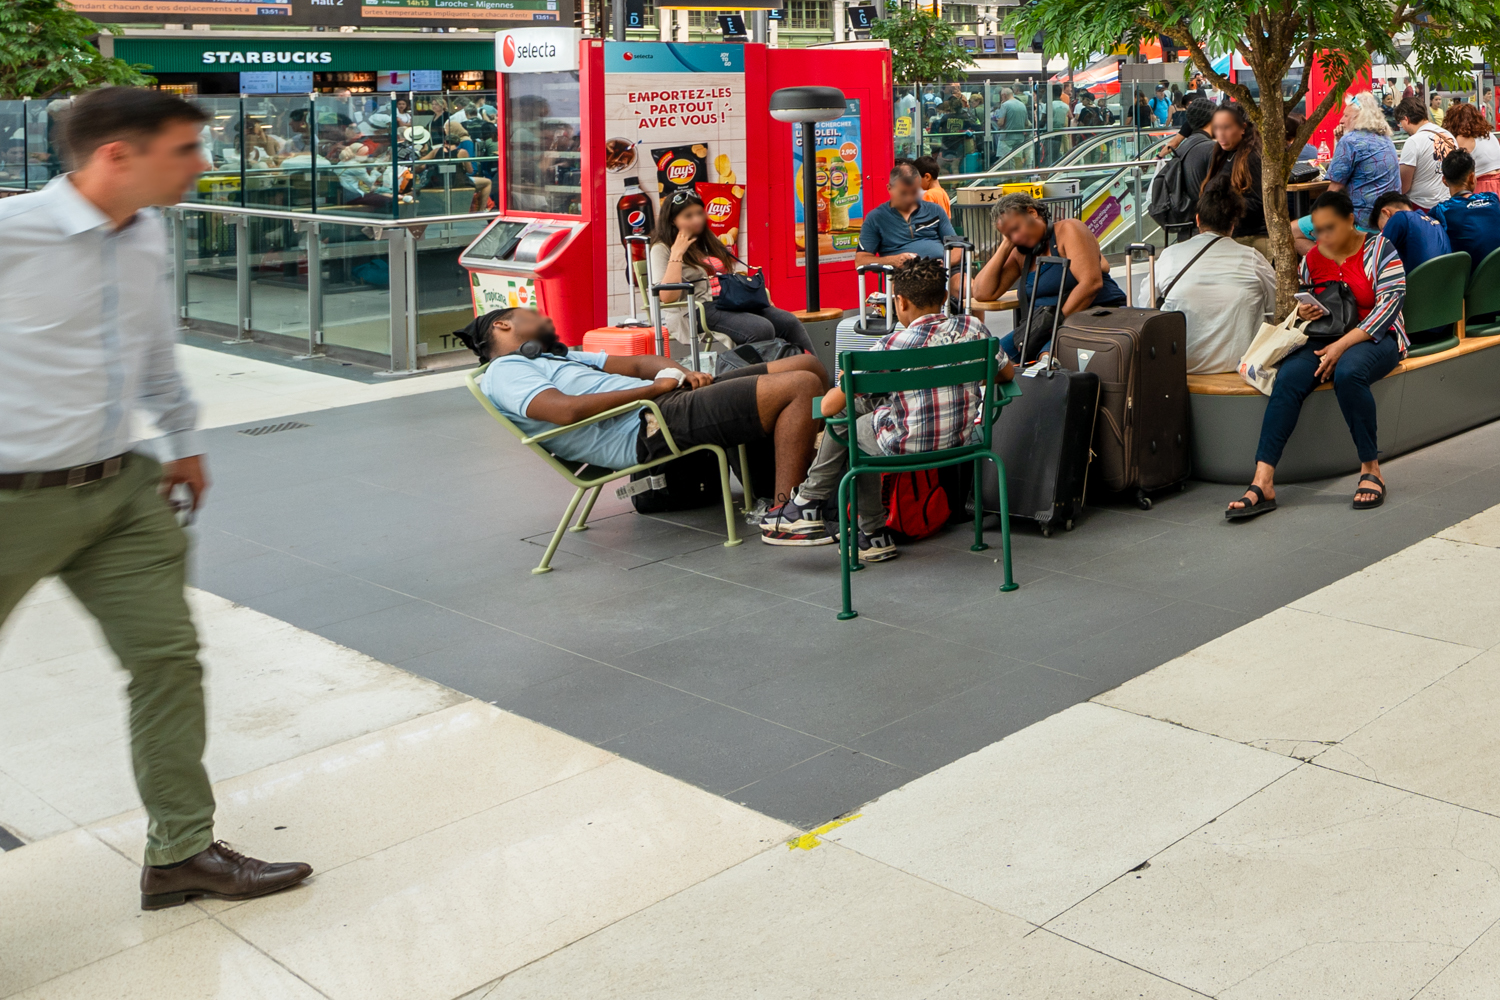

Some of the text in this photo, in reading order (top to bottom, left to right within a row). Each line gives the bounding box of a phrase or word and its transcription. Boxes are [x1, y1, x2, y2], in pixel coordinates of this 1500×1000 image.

[173, 5, 232, 13] deplacements
[476, 1, 514, 9] Migennes
[631, 16, 638, 24] D
[859, 13, 867, 24] G
[517, 42, 556, 58] selecta
[202, 52, 332, 63] STARBUCKS
[629, 88, 731, 103] EMPORTEZ-LES
[650, 102, 713, 114] PARTOUT
[638, 114, 717, 129] AVEC VOUS
[815, 129, 842, 137] OLEIL,
[824, 137, 837, 145] ICI
[670, 164, 694, 178] Lay's
[708, 202, 731, 217] Lay's
[483, 288, 508, 307] Tropicana
